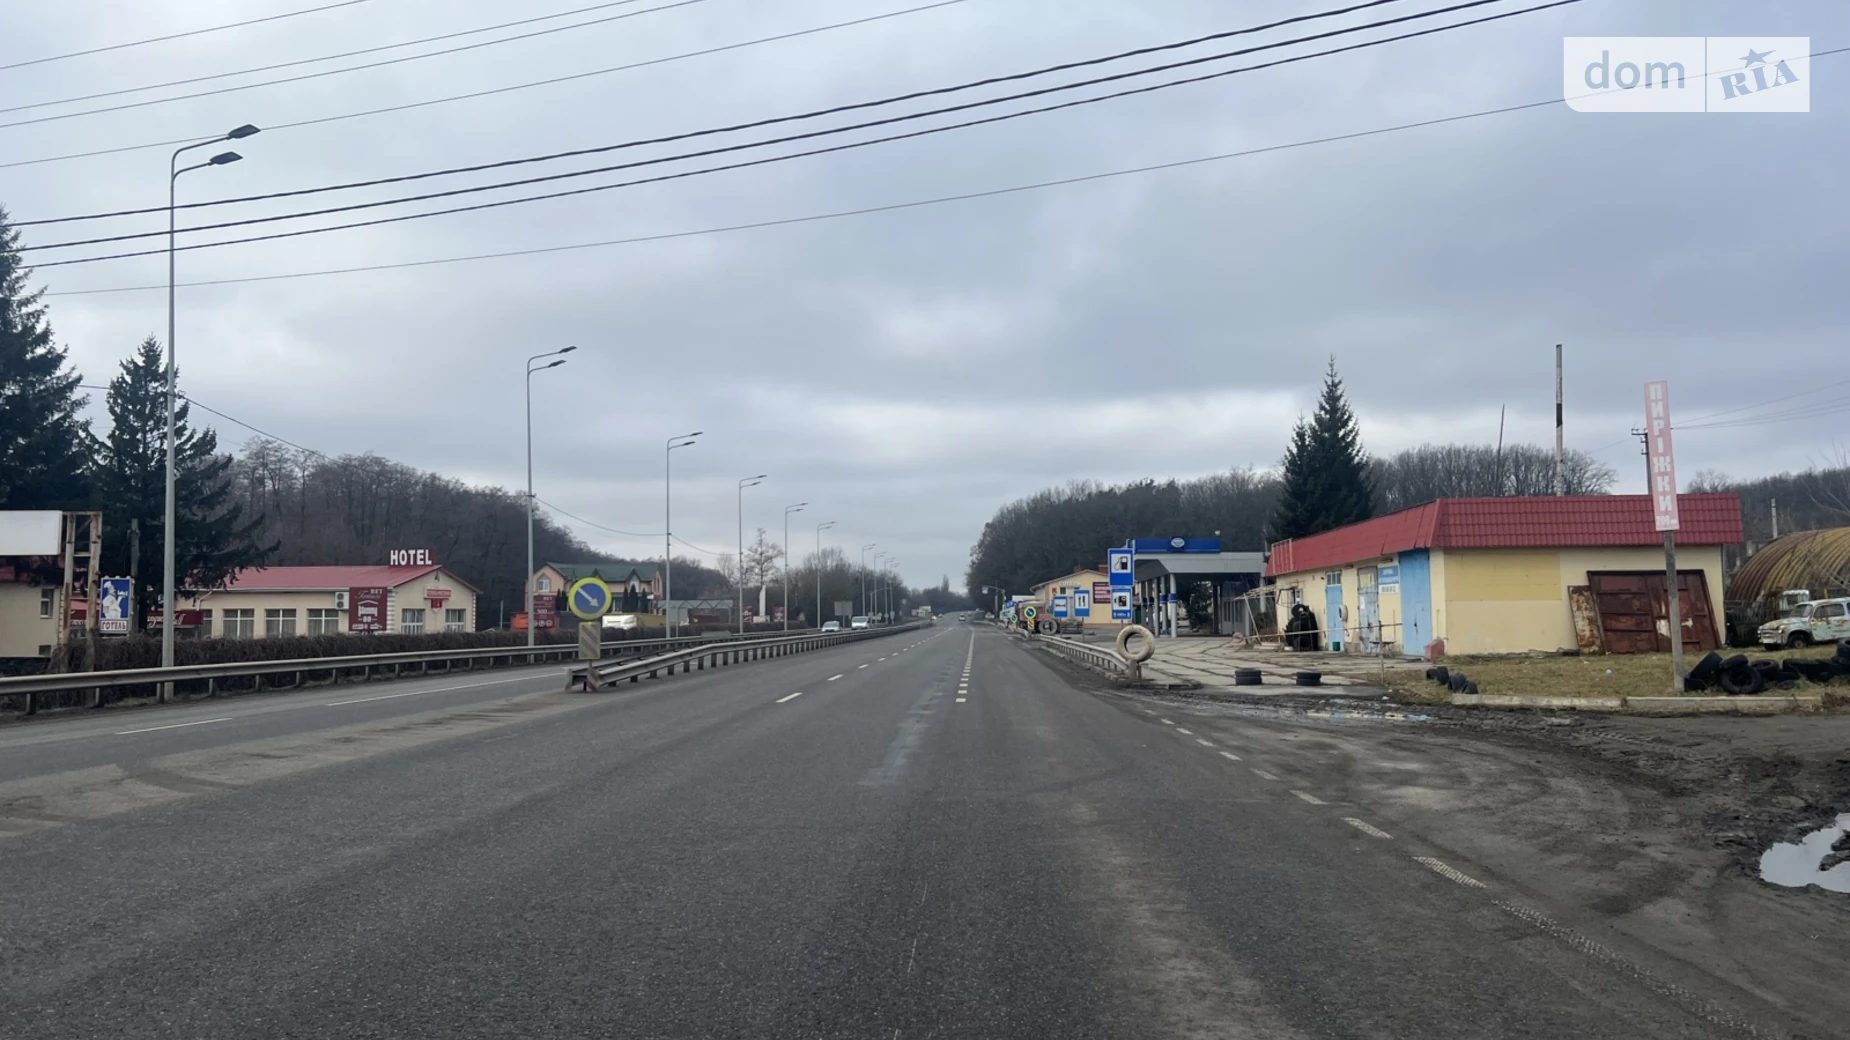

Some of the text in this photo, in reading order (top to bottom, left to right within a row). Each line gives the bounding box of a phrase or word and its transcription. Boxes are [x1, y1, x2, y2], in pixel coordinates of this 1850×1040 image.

[1648, 383, 1673, 513] ПИРІЖКИ
[390, 549, 432, 565] HOTEL
[101, 621, 126, 631] ГОТЕЛЬ
